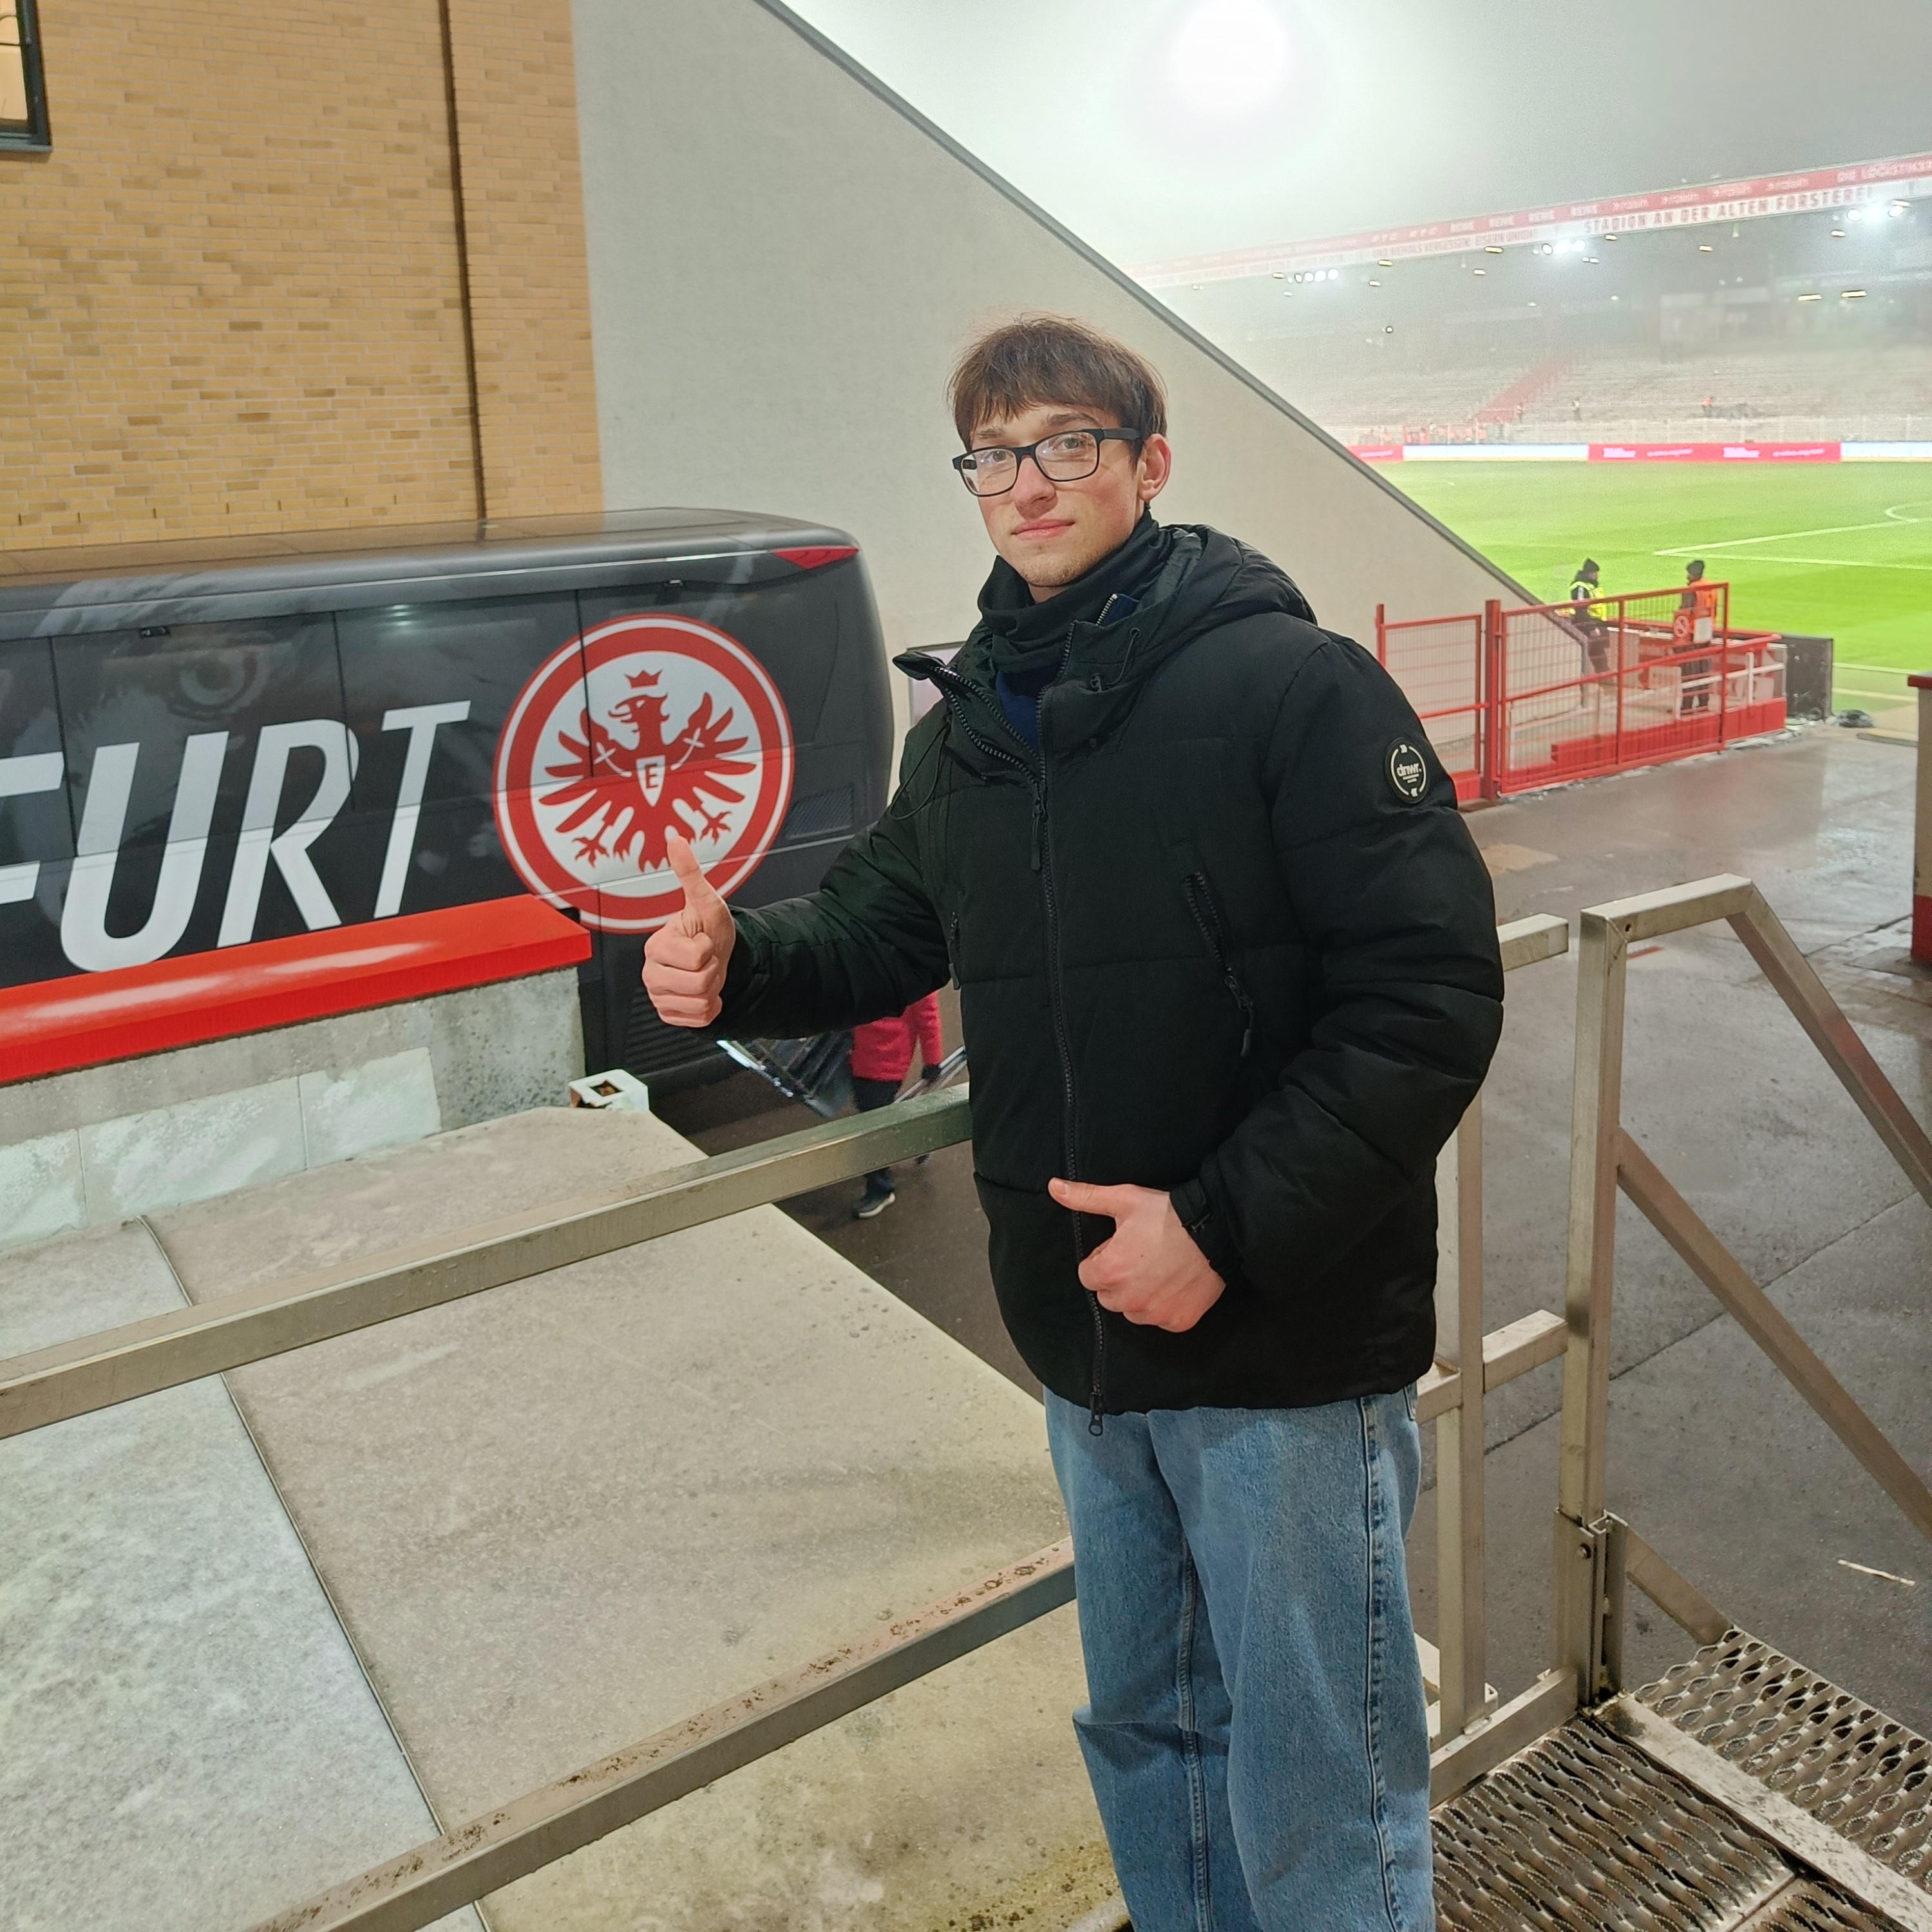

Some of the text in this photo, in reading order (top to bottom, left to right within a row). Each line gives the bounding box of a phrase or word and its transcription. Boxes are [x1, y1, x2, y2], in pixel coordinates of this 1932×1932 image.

[1586, 214, 1645, 233] STADION
[1654, 211, 1673, 224] AN
[1681, 206, 1710, 222] DER
[1717, 198, 1768, 218] ALTEN
[645, 762, 659, 789] E
